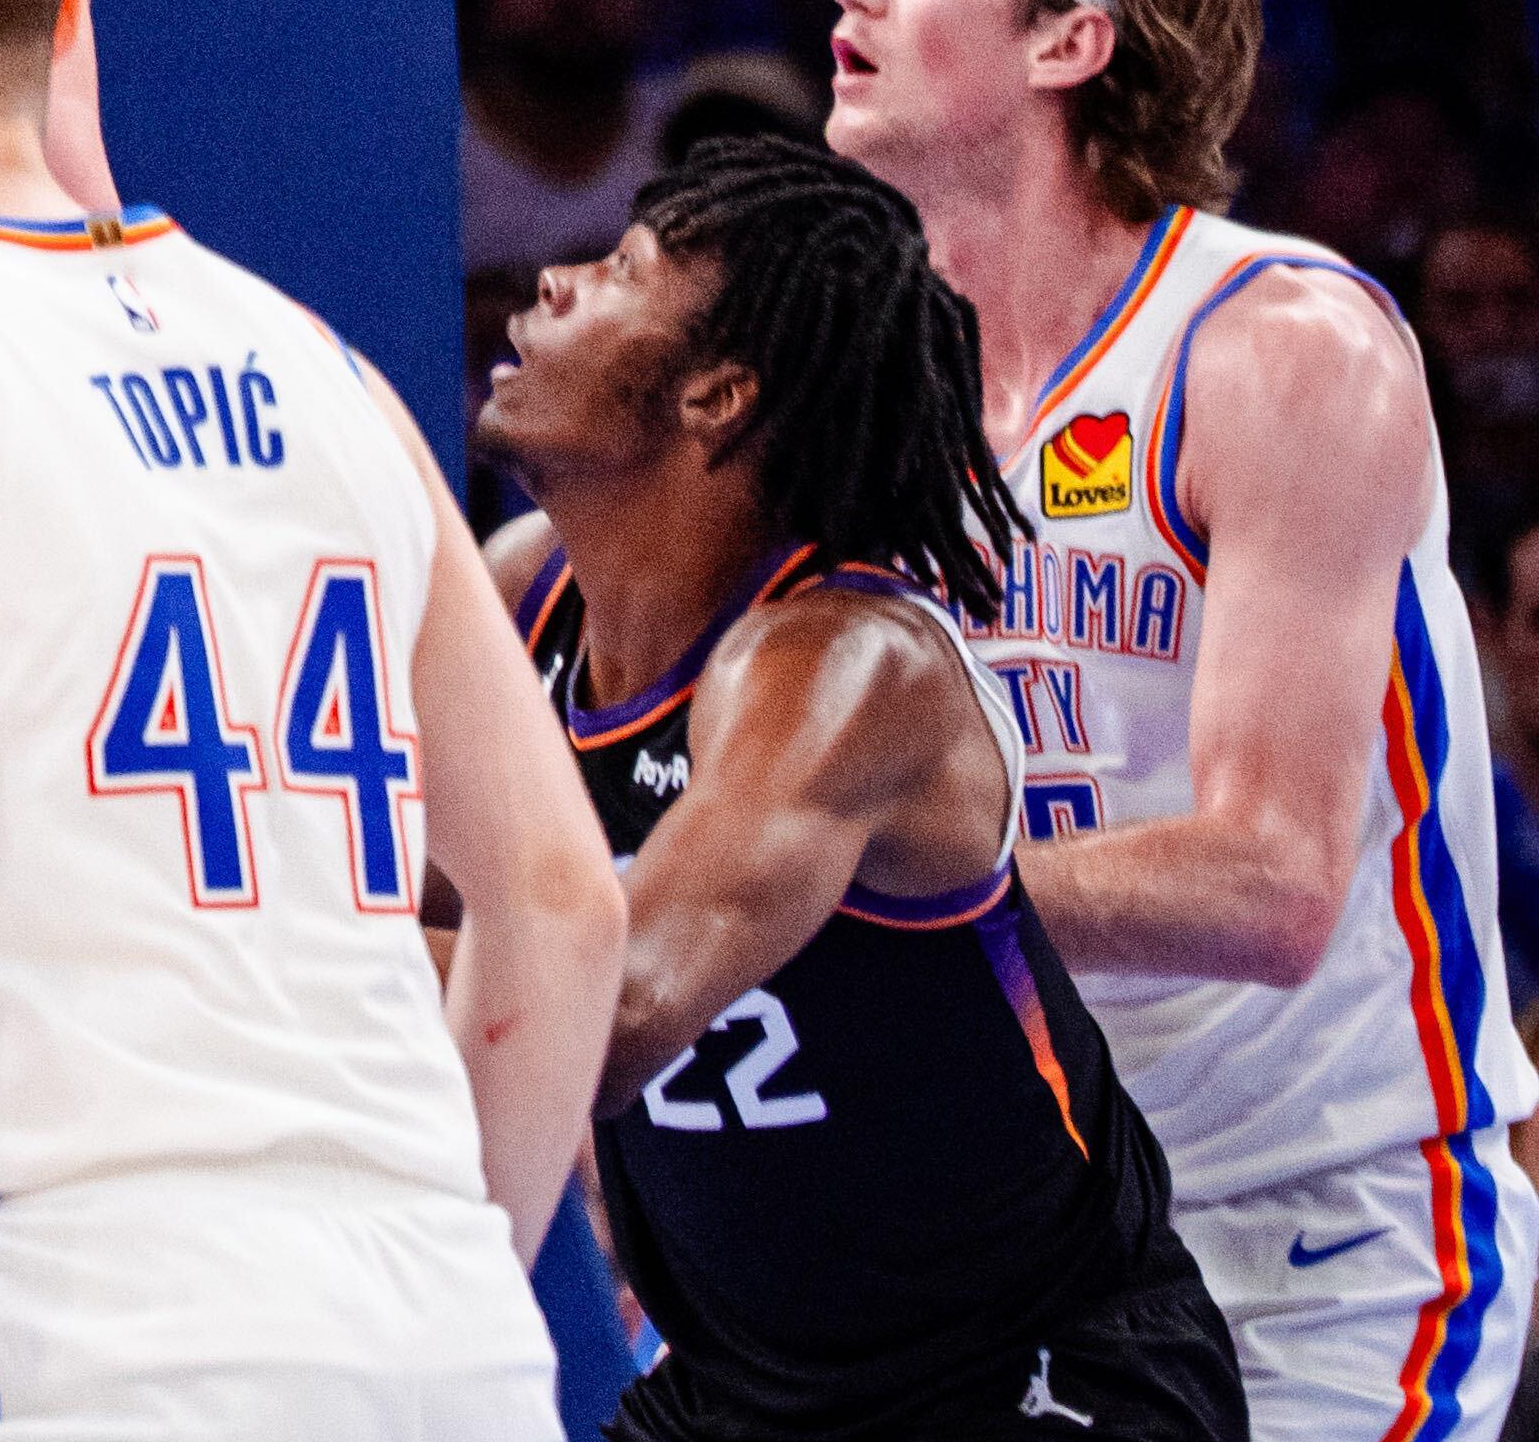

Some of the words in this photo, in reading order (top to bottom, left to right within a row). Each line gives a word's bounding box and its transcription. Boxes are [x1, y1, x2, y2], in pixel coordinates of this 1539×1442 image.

[91, 350, 285, 471] TOPIĆ
[948, 538, 1186, 664] HOMA
[86, 554, 422, 913] 44
[990, 658, 1090, 755] TY
